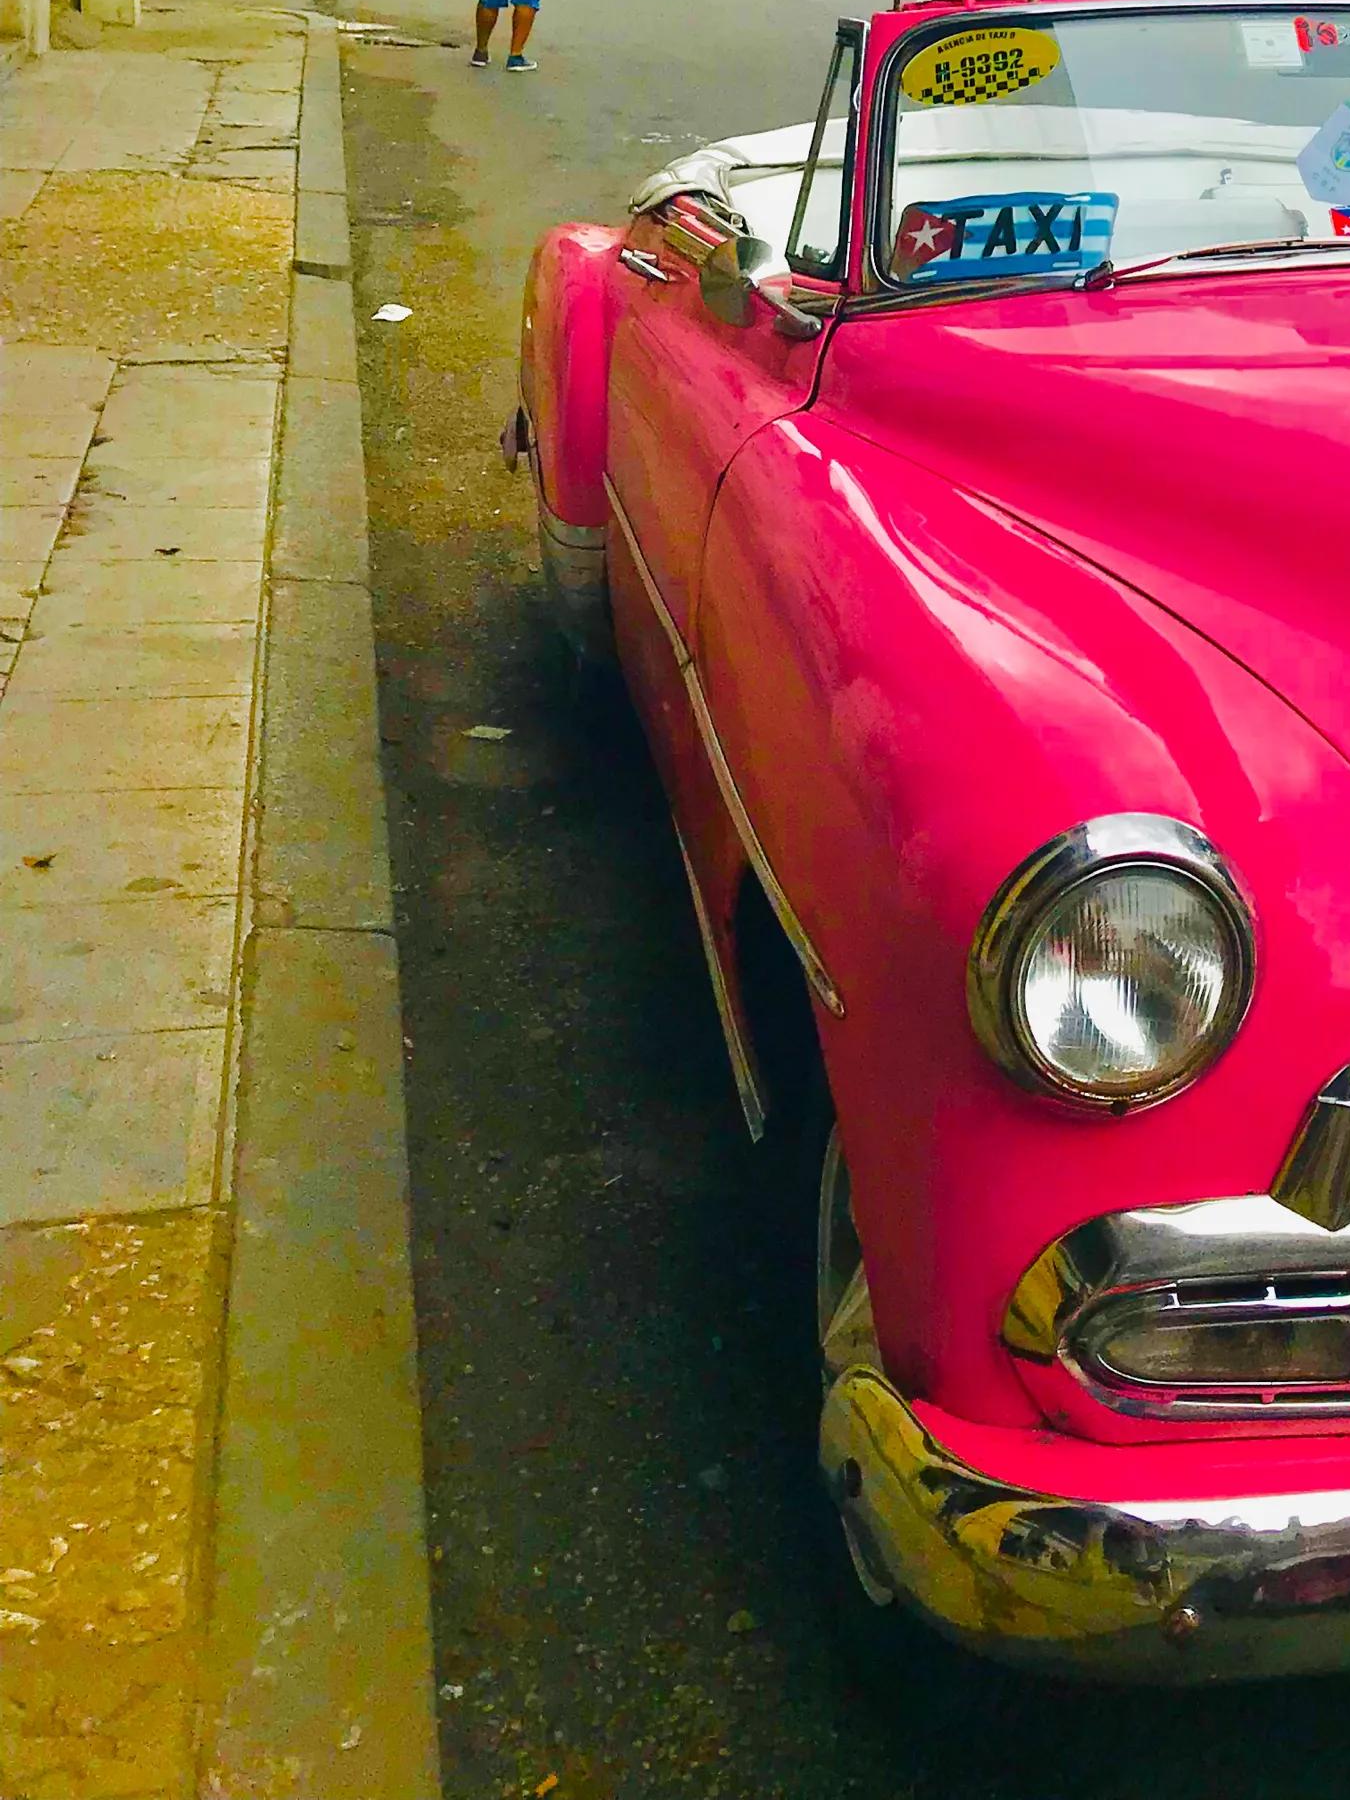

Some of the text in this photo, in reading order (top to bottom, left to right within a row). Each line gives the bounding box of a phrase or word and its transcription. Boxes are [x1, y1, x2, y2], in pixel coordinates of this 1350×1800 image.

[937, 35, 974, 54] AGENCIA
[976, 32, 986, 41] DE
[989, 31, 1008, 39] TAXI
[935, 48, 1024, 84] H-9392
[941, 203, 1082, 260] TAXI
